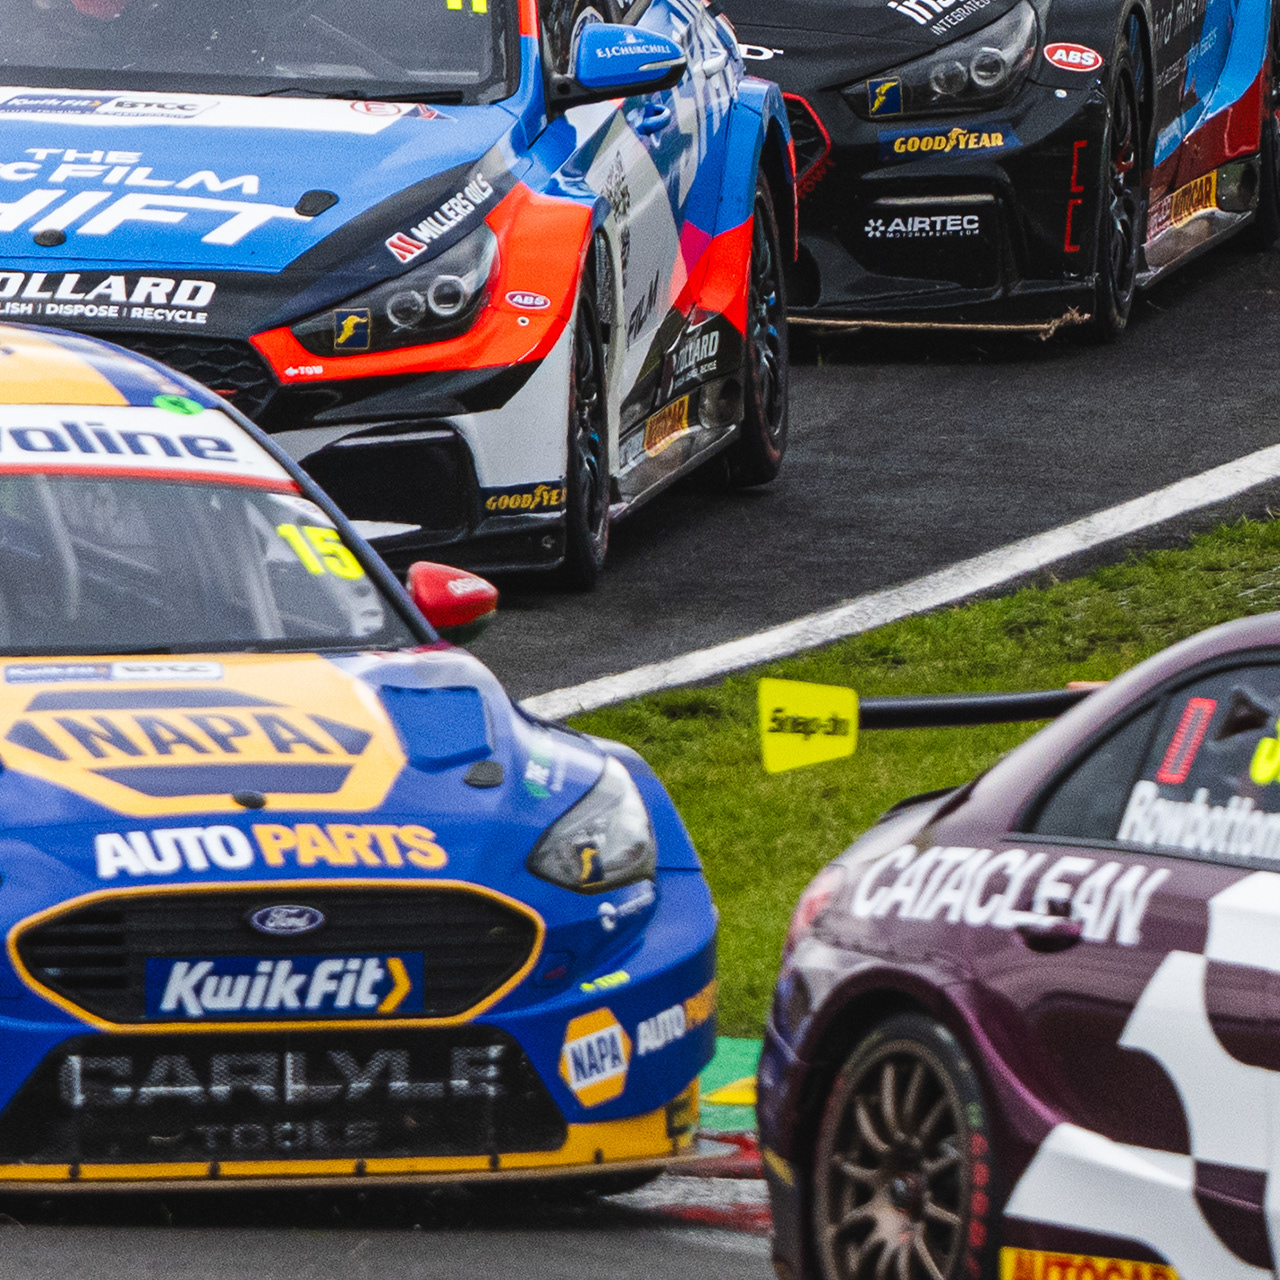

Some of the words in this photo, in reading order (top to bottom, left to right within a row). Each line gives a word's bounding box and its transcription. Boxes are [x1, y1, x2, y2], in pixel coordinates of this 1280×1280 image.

[1052, 47, 1096, 67] ABS
[894, 126, 1004, 154] GOODYEAR
[24, 147, 144, 165] THE
[48, 164, 260, 195] FILM
[409, 194, 470, 244] MILLERS
[464, 172, 495, 211] OILS
[887, 215, 980, 232] AIRTEC
[46, 302, 120, 319] DISPOSE
[131, 305, 208, 325] RECYCLE
[512, 292, 545, 307] ABS
[298, 364, 324, 376] TOW
[277, 522, 366, 581] 15
[60, 714, 317, 758] NAPA
[95, 825, 255, 878] AUTO
[252, 823, 448, 869] PARTS
[851, 844, 1172, 948] CATACLEAN
[159, 957, 385, 1018] KwikFit
[570, 1030, 626, 1083] NAPA
[57, 1044, 505, 1108] CARLYLE
[194, 1121, 378, 1150] TOOLS
